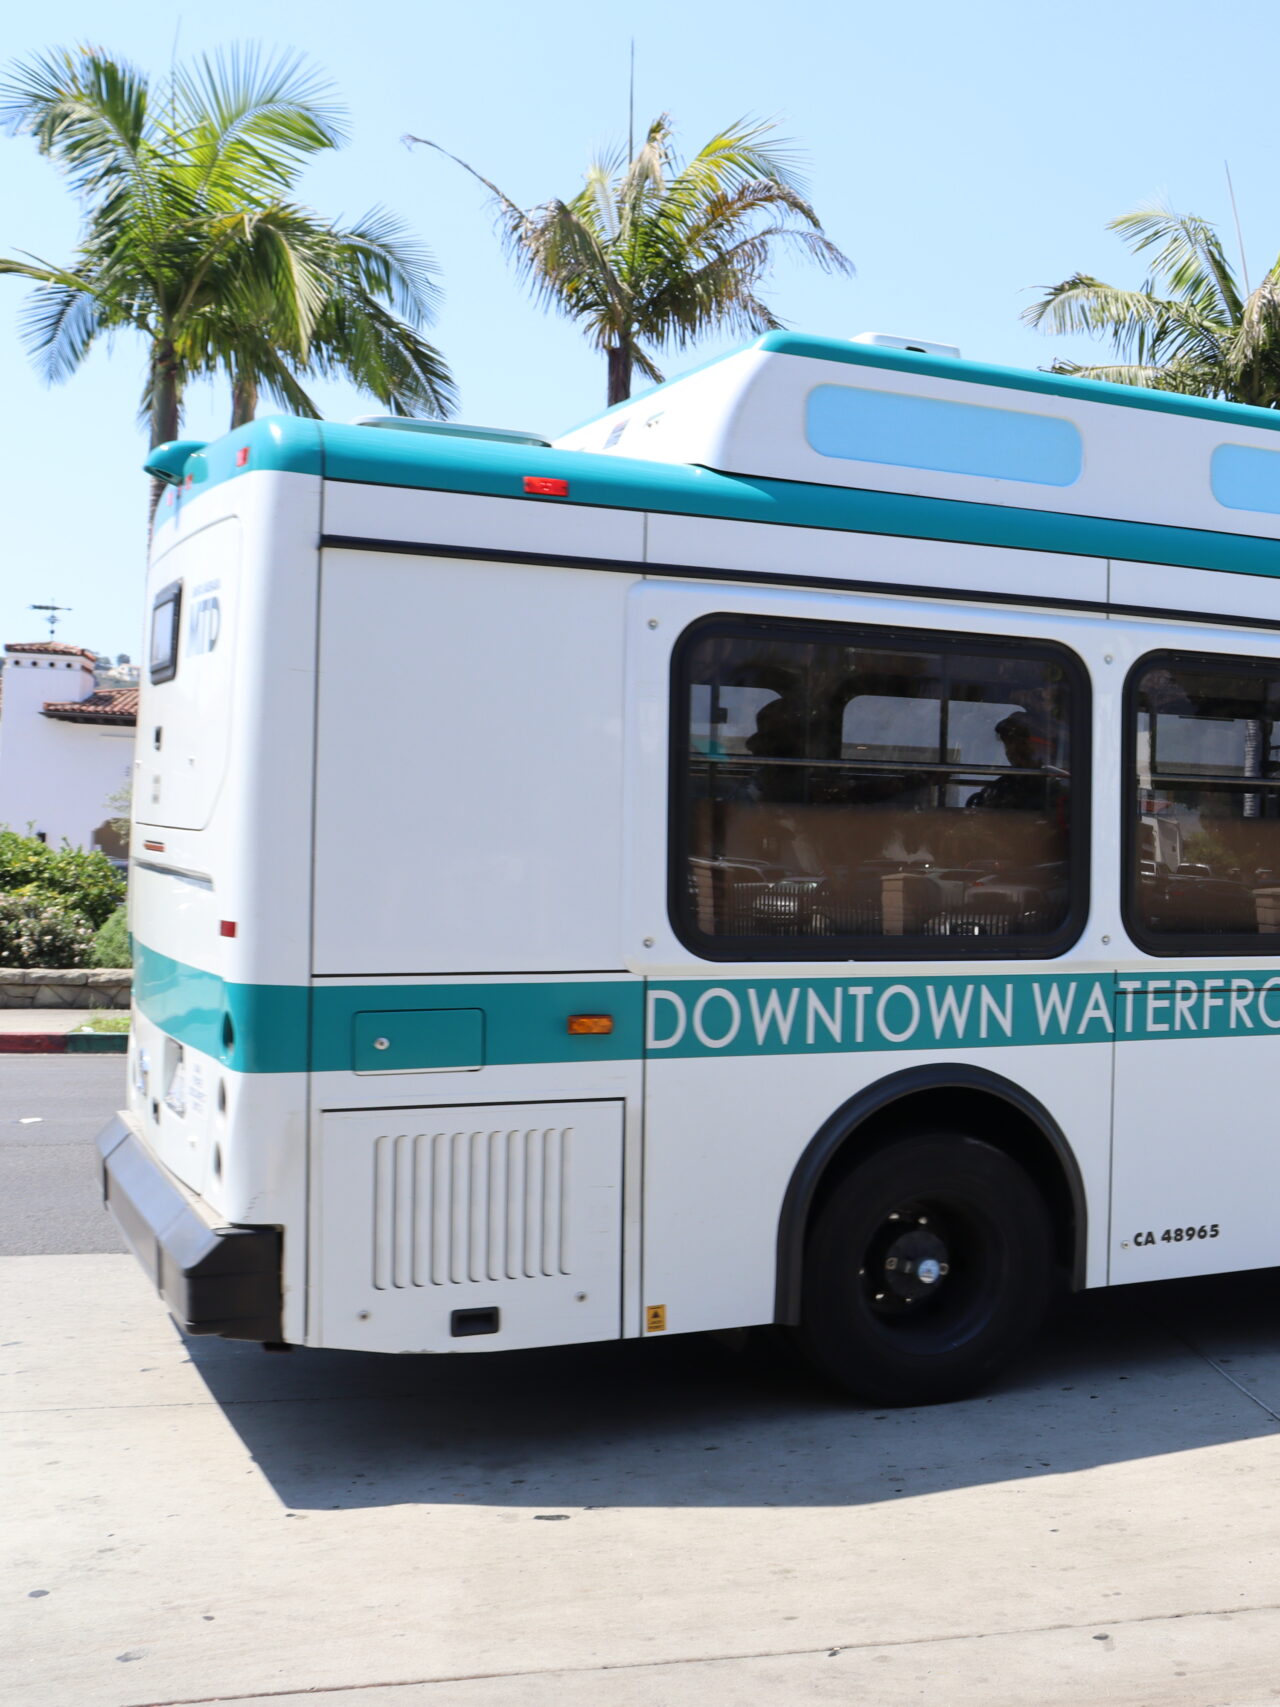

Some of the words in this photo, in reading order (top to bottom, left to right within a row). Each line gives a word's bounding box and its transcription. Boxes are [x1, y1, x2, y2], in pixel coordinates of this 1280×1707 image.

[646, 983, 1014, 1049] DOWNTOWN
[1133, 1231, 1156, 1247] CA
[1160, 1223, 1220, 1243] 48965
